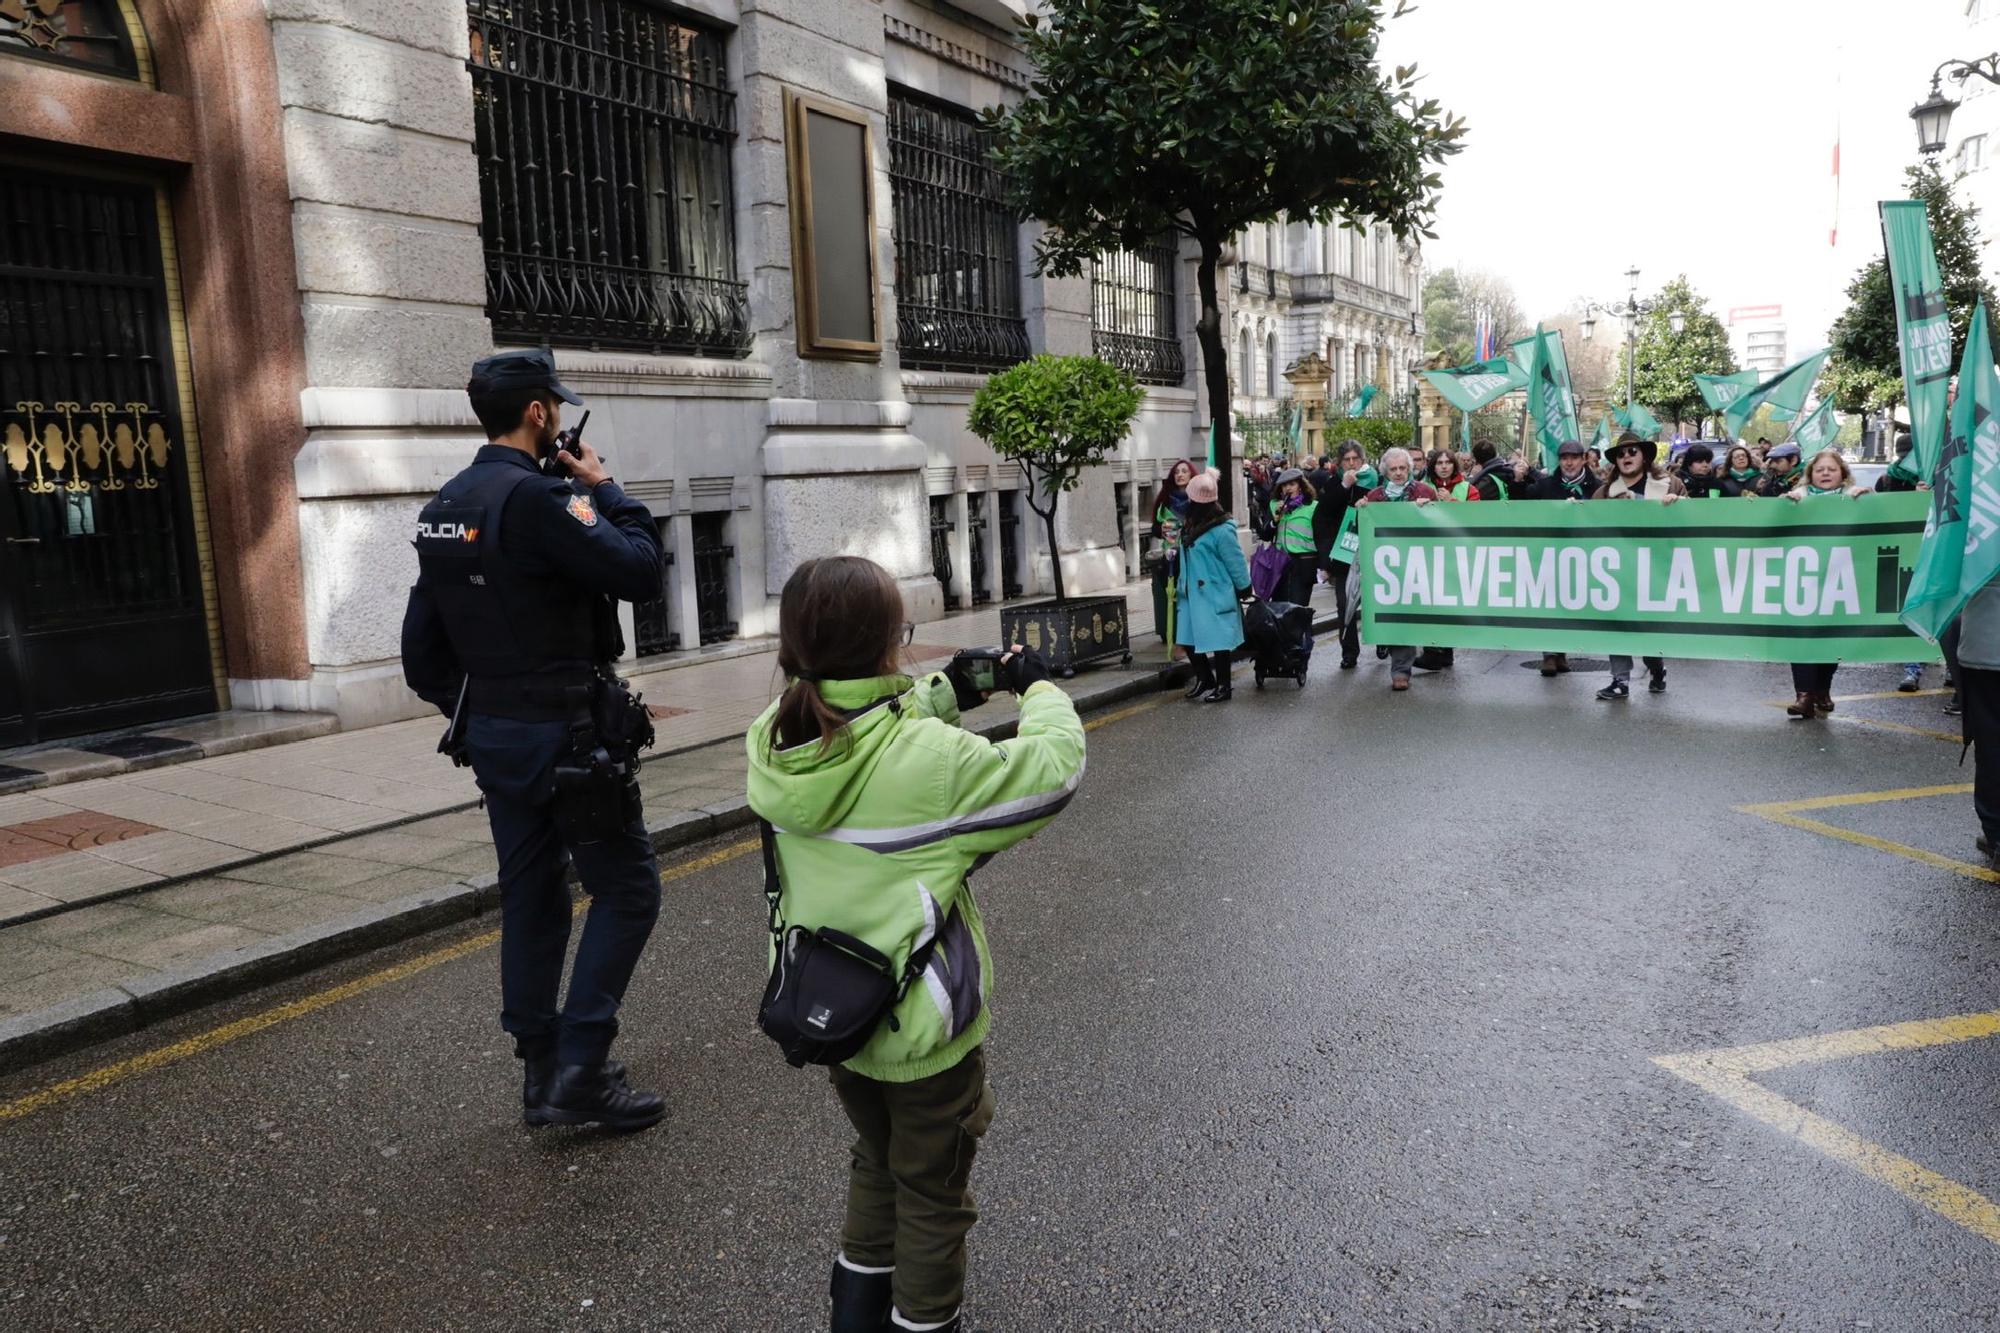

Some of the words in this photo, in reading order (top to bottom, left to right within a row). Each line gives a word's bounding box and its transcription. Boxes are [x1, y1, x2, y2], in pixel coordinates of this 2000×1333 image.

[417, 523, 468, 539] POLICIA
[1373, 544, 1621, 611] SALVEMOS
[1637, 547, 1701, 614] LA
[1713, 545, 1860, 617] VEGA
